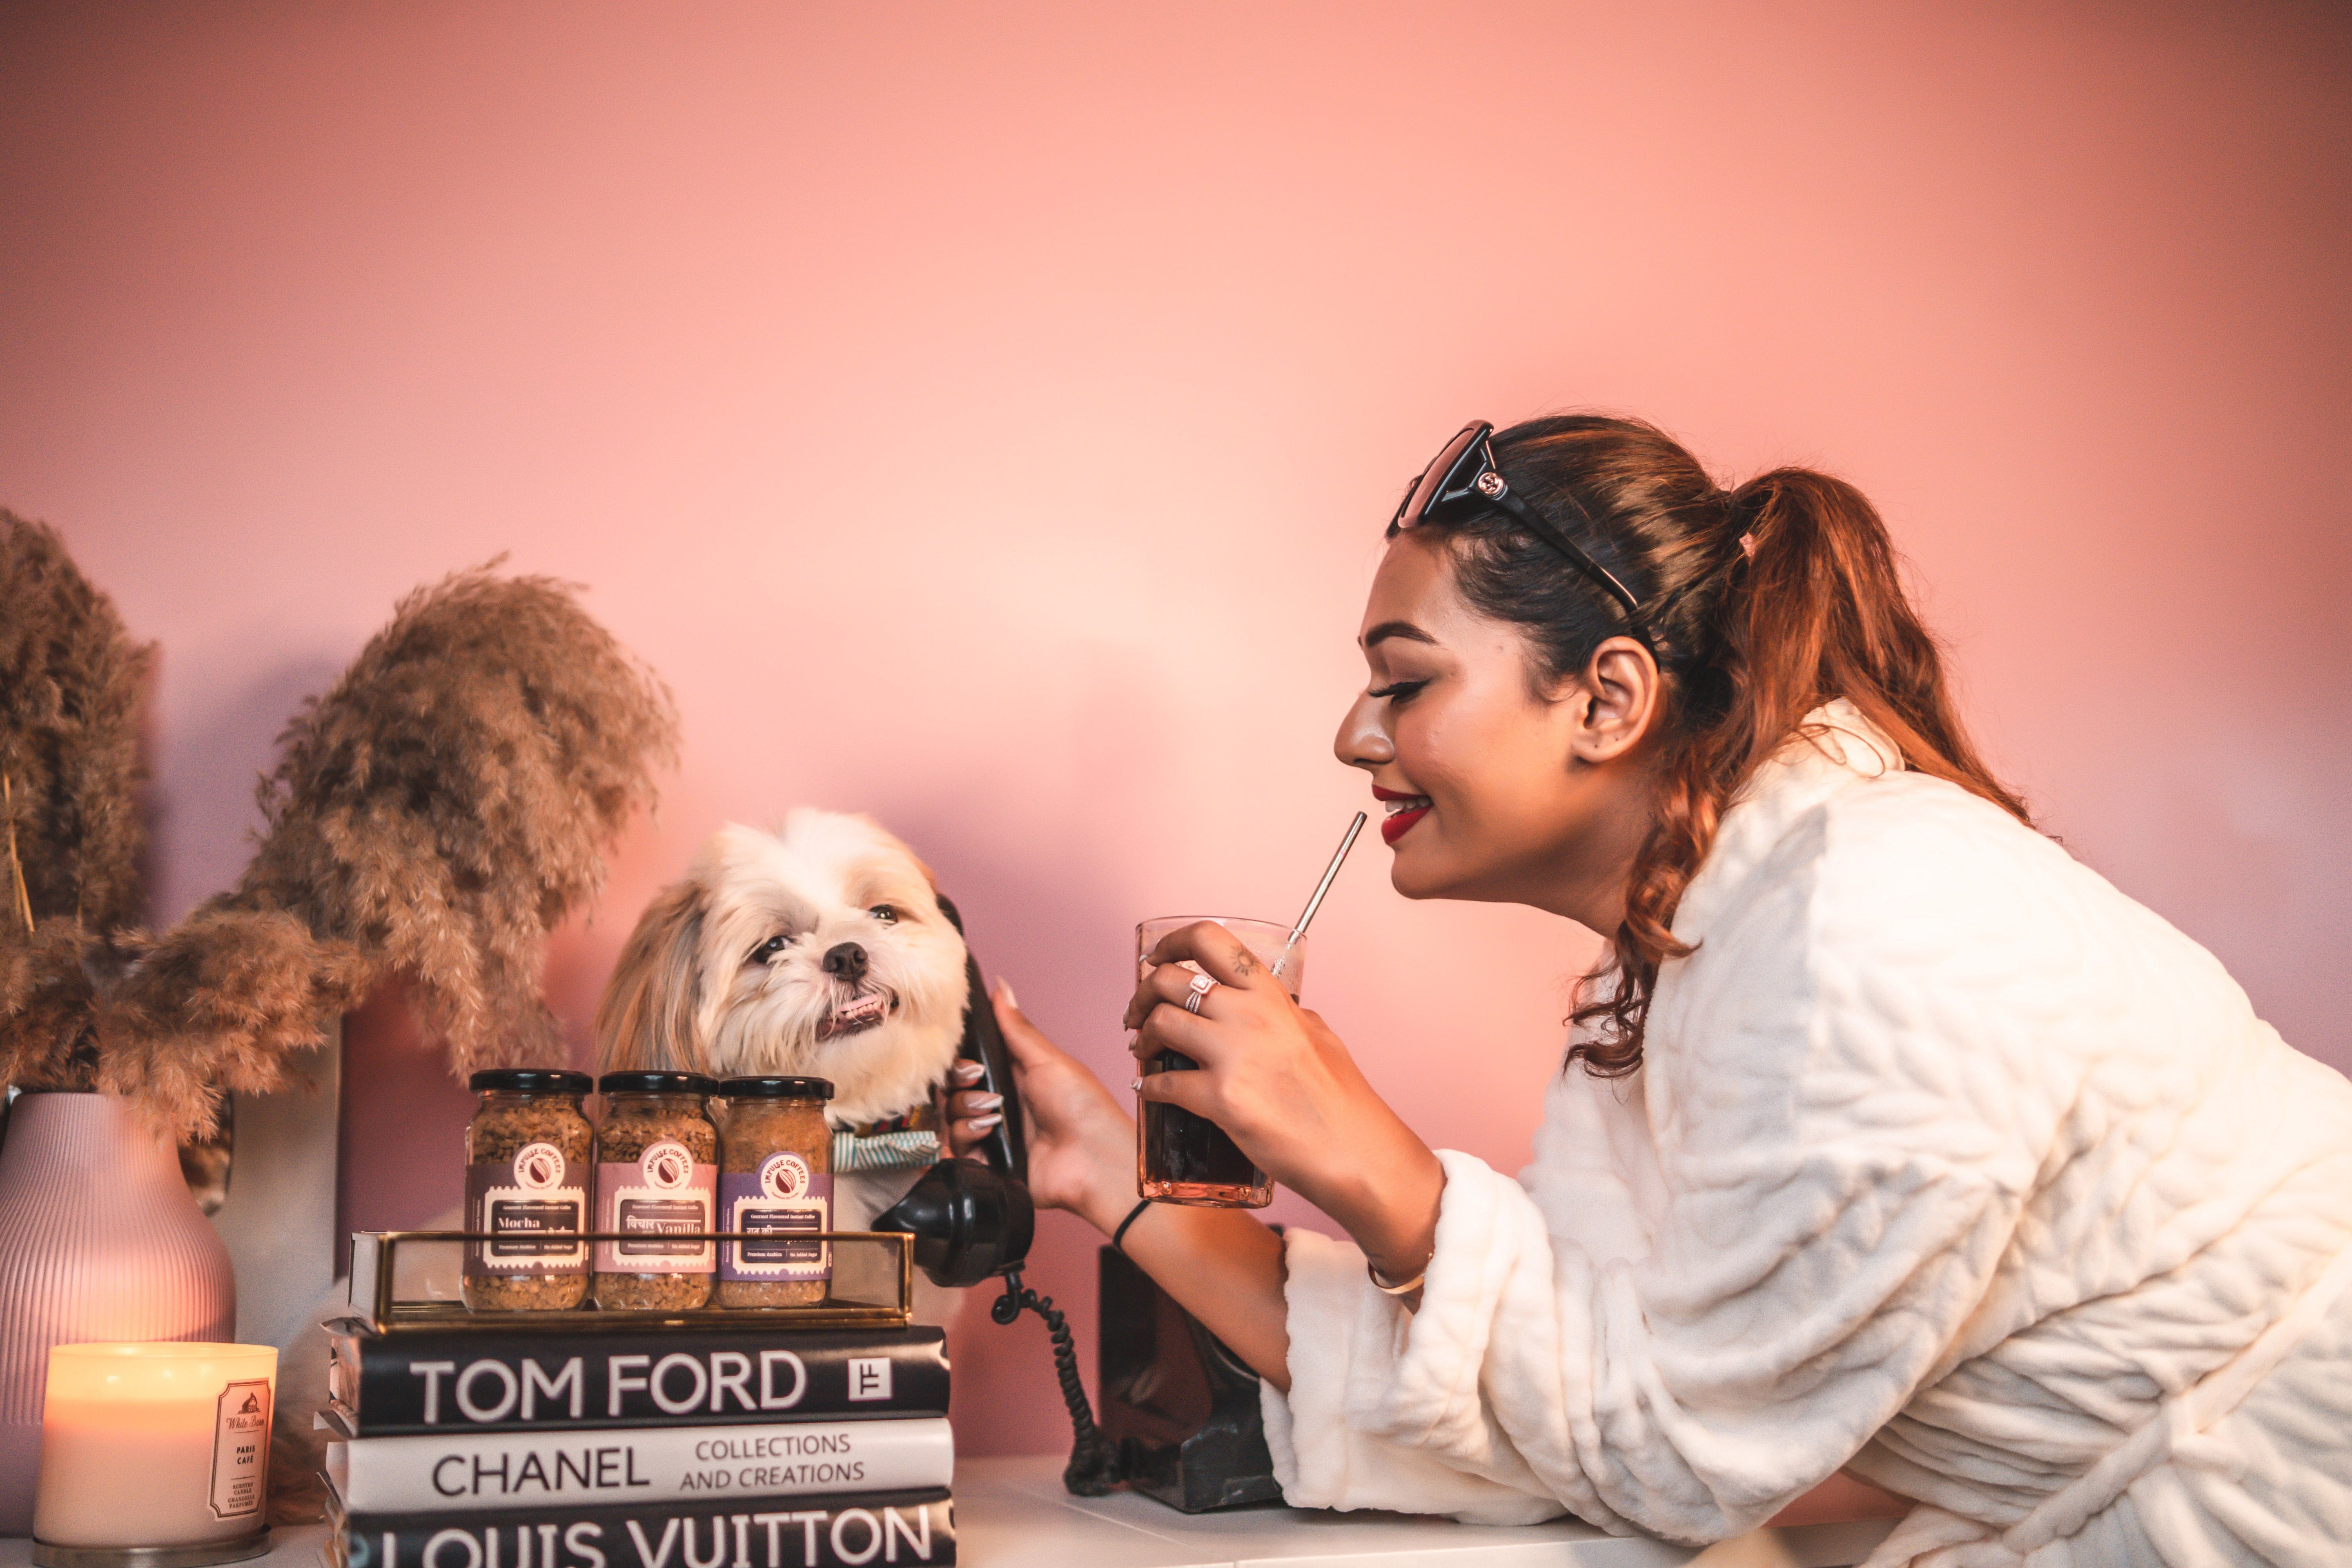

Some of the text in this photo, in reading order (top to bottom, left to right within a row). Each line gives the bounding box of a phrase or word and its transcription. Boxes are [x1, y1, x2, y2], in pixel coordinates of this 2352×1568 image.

[519, 1148, 561, 1173] IMPULSE COFFEES
[647, 1149, 688, 1174] IMPULSE COFFEES
[765, 1160, 805, 1184] IMPULSE COFFEES
[498, 1217, 540, 1228] Mocha
[626, 1215, 655, 1229] विचार
[656, 1223, 700, 1234] Vanilla
[410, 1350, 807, 1424] TOM FORD
[860, 1363, 880, 1394] TF
[226, 1415, 265, 1429] White Barn
[237, 1445, 255, 1454] PARIS
[237, 1454, 254, 1464] CAFÉ
[695, 1434, 851, 1461] COLLECTIONS
[432, 1447, 650, 1497] CHANEL
[680, 1461, 865, 1491] AND CREATIONS
[626, 1506, 932, 1568] VUITTON
